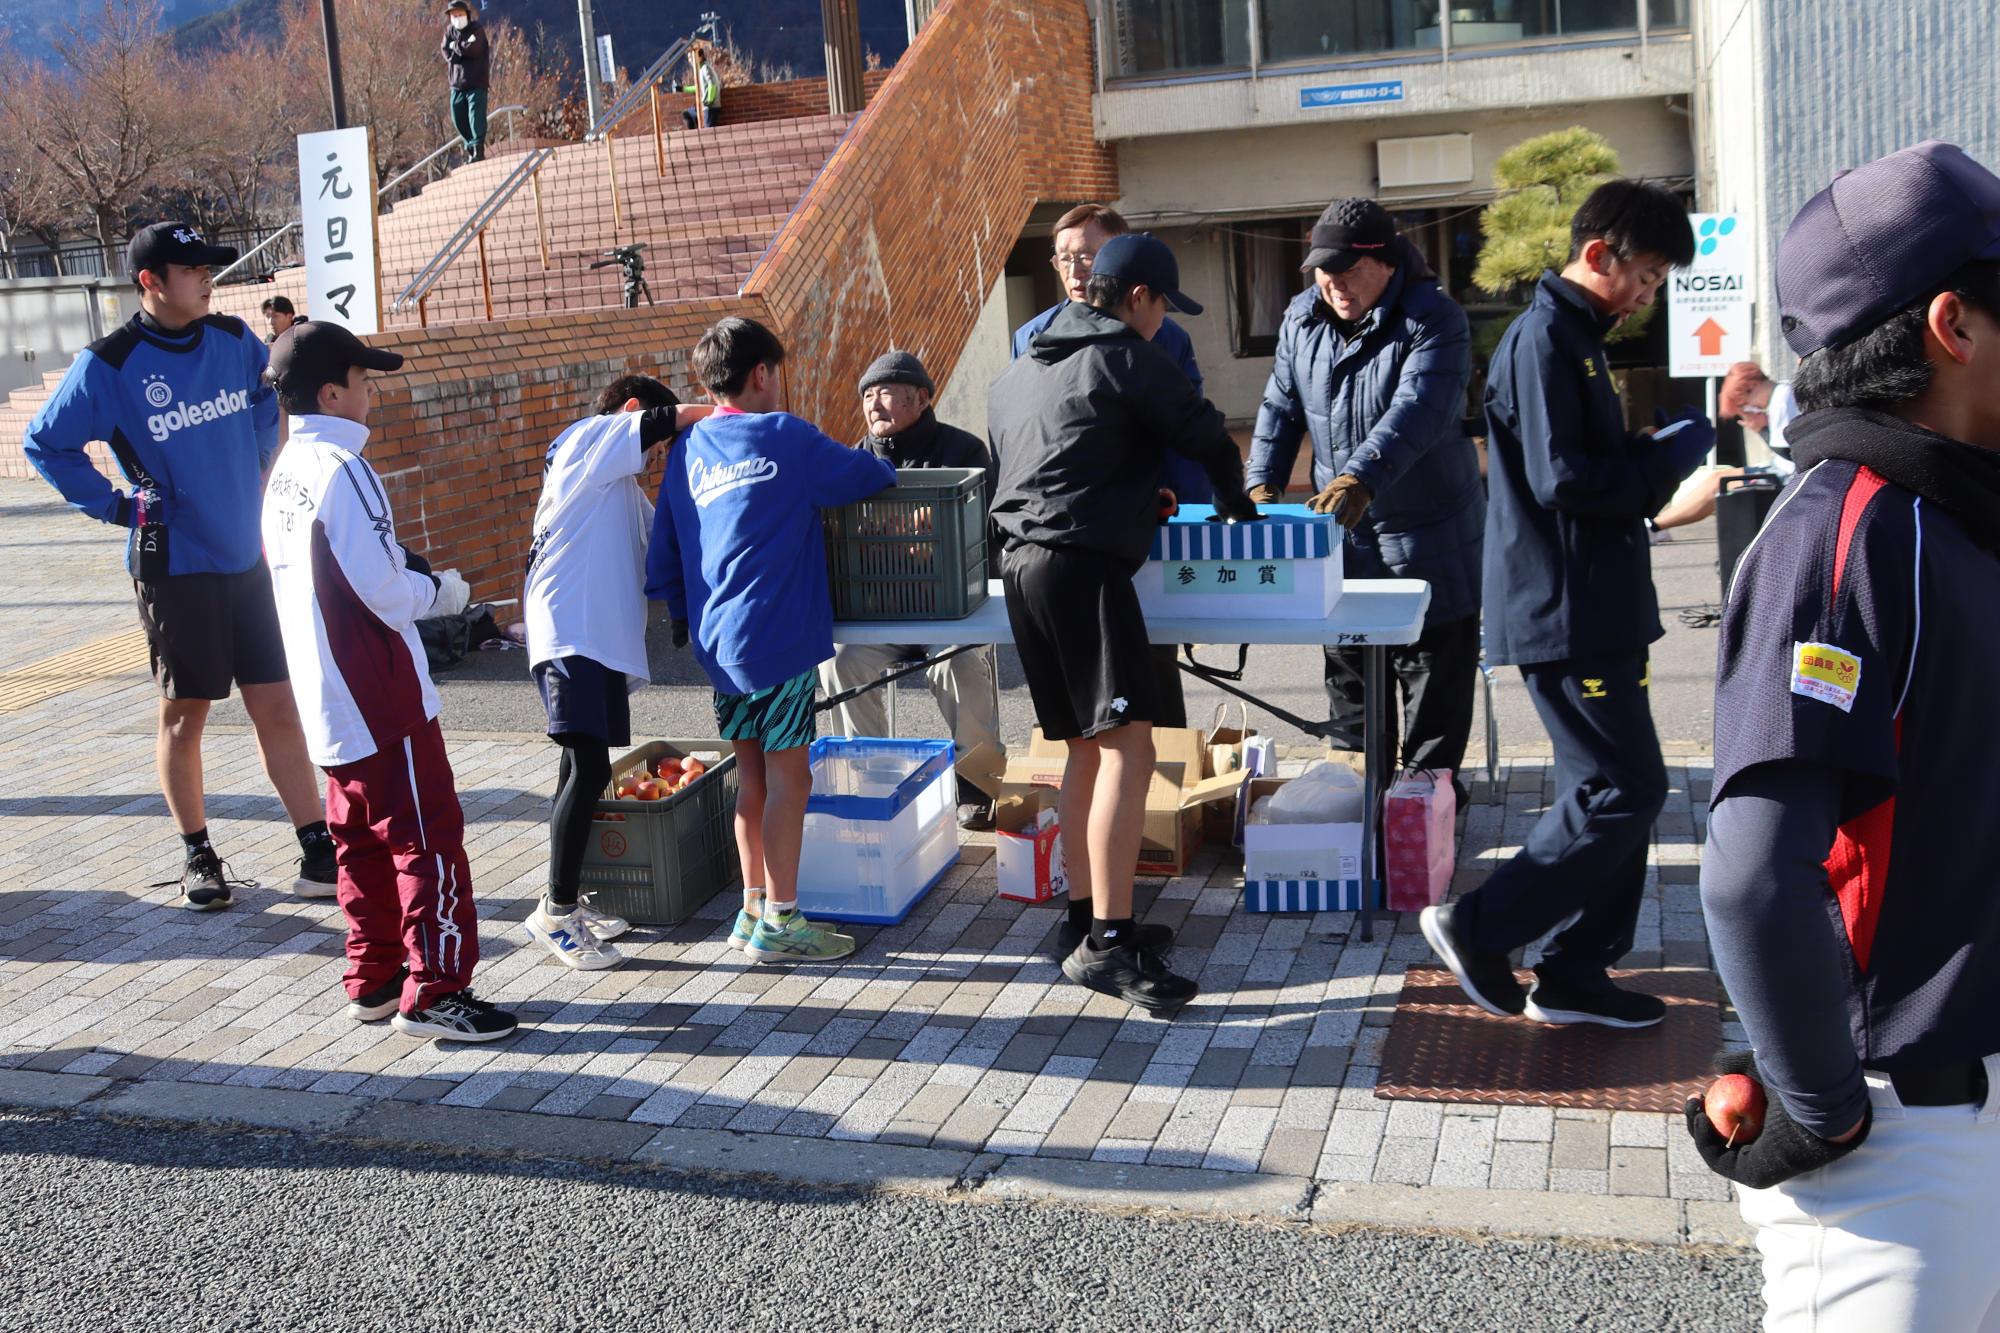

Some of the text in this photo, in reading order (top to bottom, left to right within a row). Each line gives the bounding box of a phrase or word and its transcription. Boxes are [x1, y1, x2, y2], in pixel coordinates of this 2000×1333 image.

[318, 152, 356, 320] 元旦マ
[1676, 275, 1743, 292] NOSAI
[147, 388, 248, 442] goleador
[689, 457, 778, 500] Chikuma
[1177, 564, 1277, 585] 参加賞
